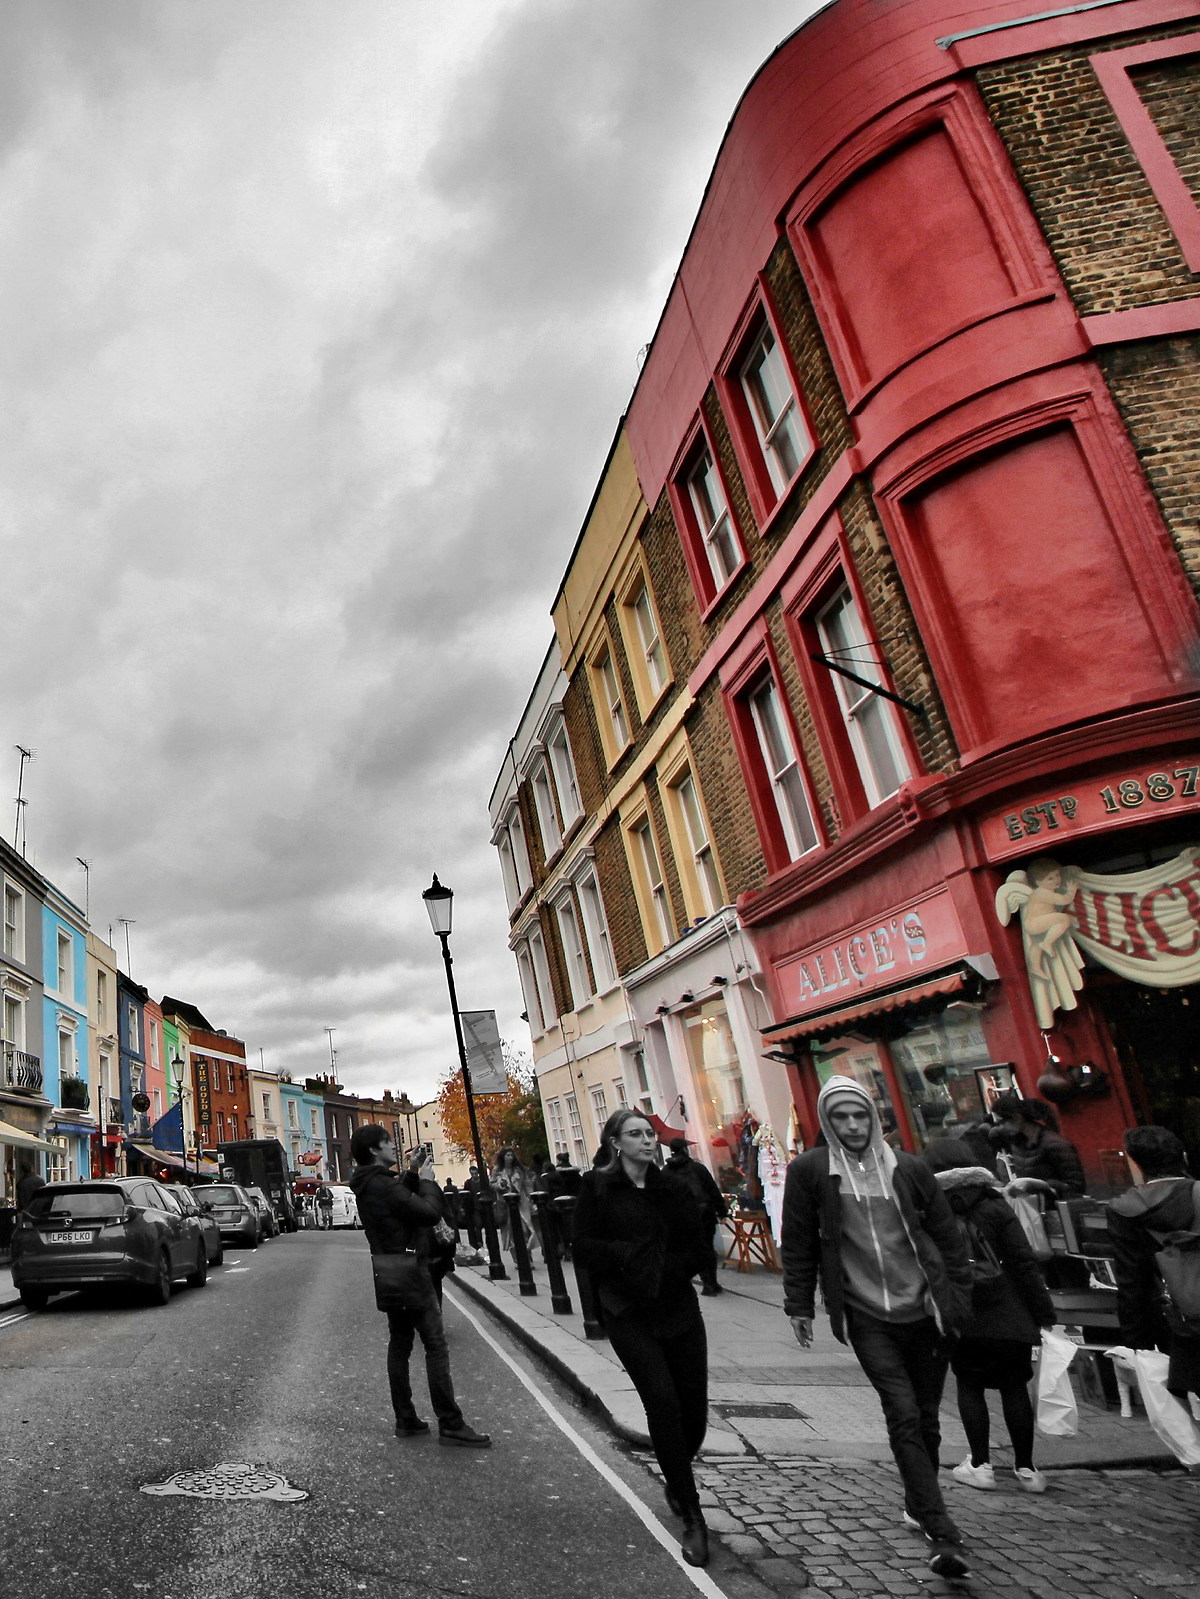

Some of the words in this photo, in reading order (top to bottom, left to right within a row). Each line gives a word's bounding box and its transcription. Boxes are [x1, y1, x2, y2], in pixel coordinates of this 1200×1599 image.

[1101, 766, 1200, 813] 1887
[799, 912, 927, 1001] ALICE'S
[197, 1063, 206, 1082] THE
[199, 1085, 209, 1110] GOLD
[52, 1233, 73, 1242] LP66
